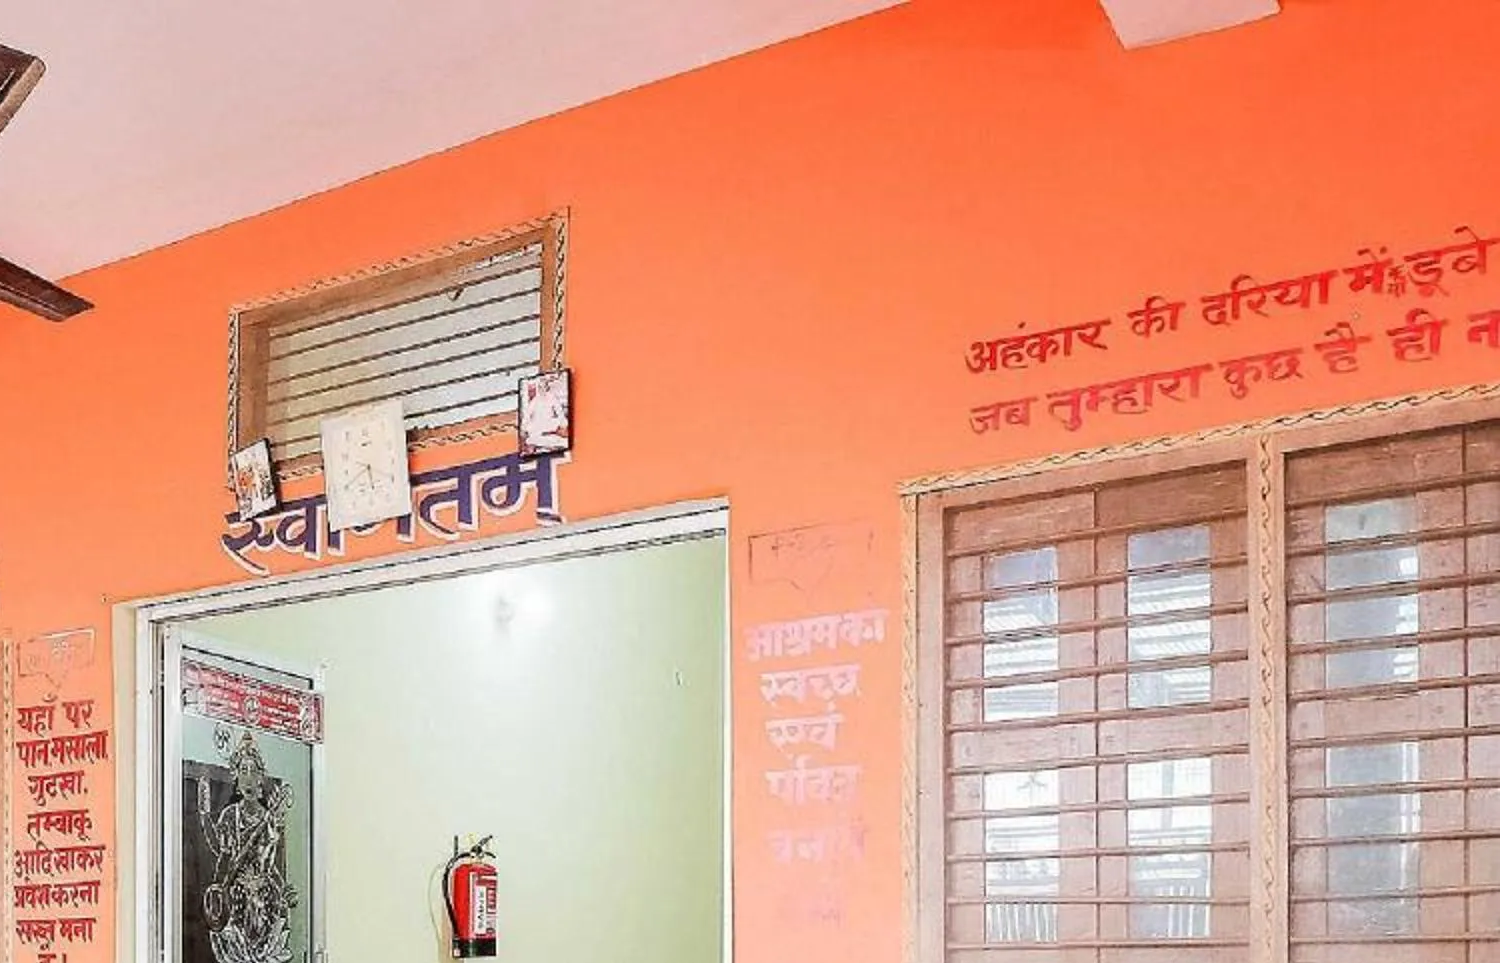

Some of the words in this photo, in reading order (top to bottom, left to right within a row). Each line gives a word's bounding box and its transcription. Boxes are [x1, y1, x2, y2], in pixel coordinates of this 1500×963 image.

[965, 322, 1111, 374] अहंकार
[1127, 296, 1186, 338] की
[1201, 270, 1338, 326] दरिया
[1342, 246, 1394, 294] में
[969, 396, 1037, 435] जब
[1046, 363, 1214, 432] तुम्हारा
[1219, 347, 1303, 400] कुछ
[1314, 322, 1372, 374] है
[1386, 308, 1449, 363] ही
[17, 693, 58, 738] यहाँ
[62, 699, 94, 728] पर
[27, 809, 92, 841] तम्बाकू
[53, 844, 105, 875] खाकर
[50, 880, 100, 908] करना
[59, 918, 96, 942] मना
